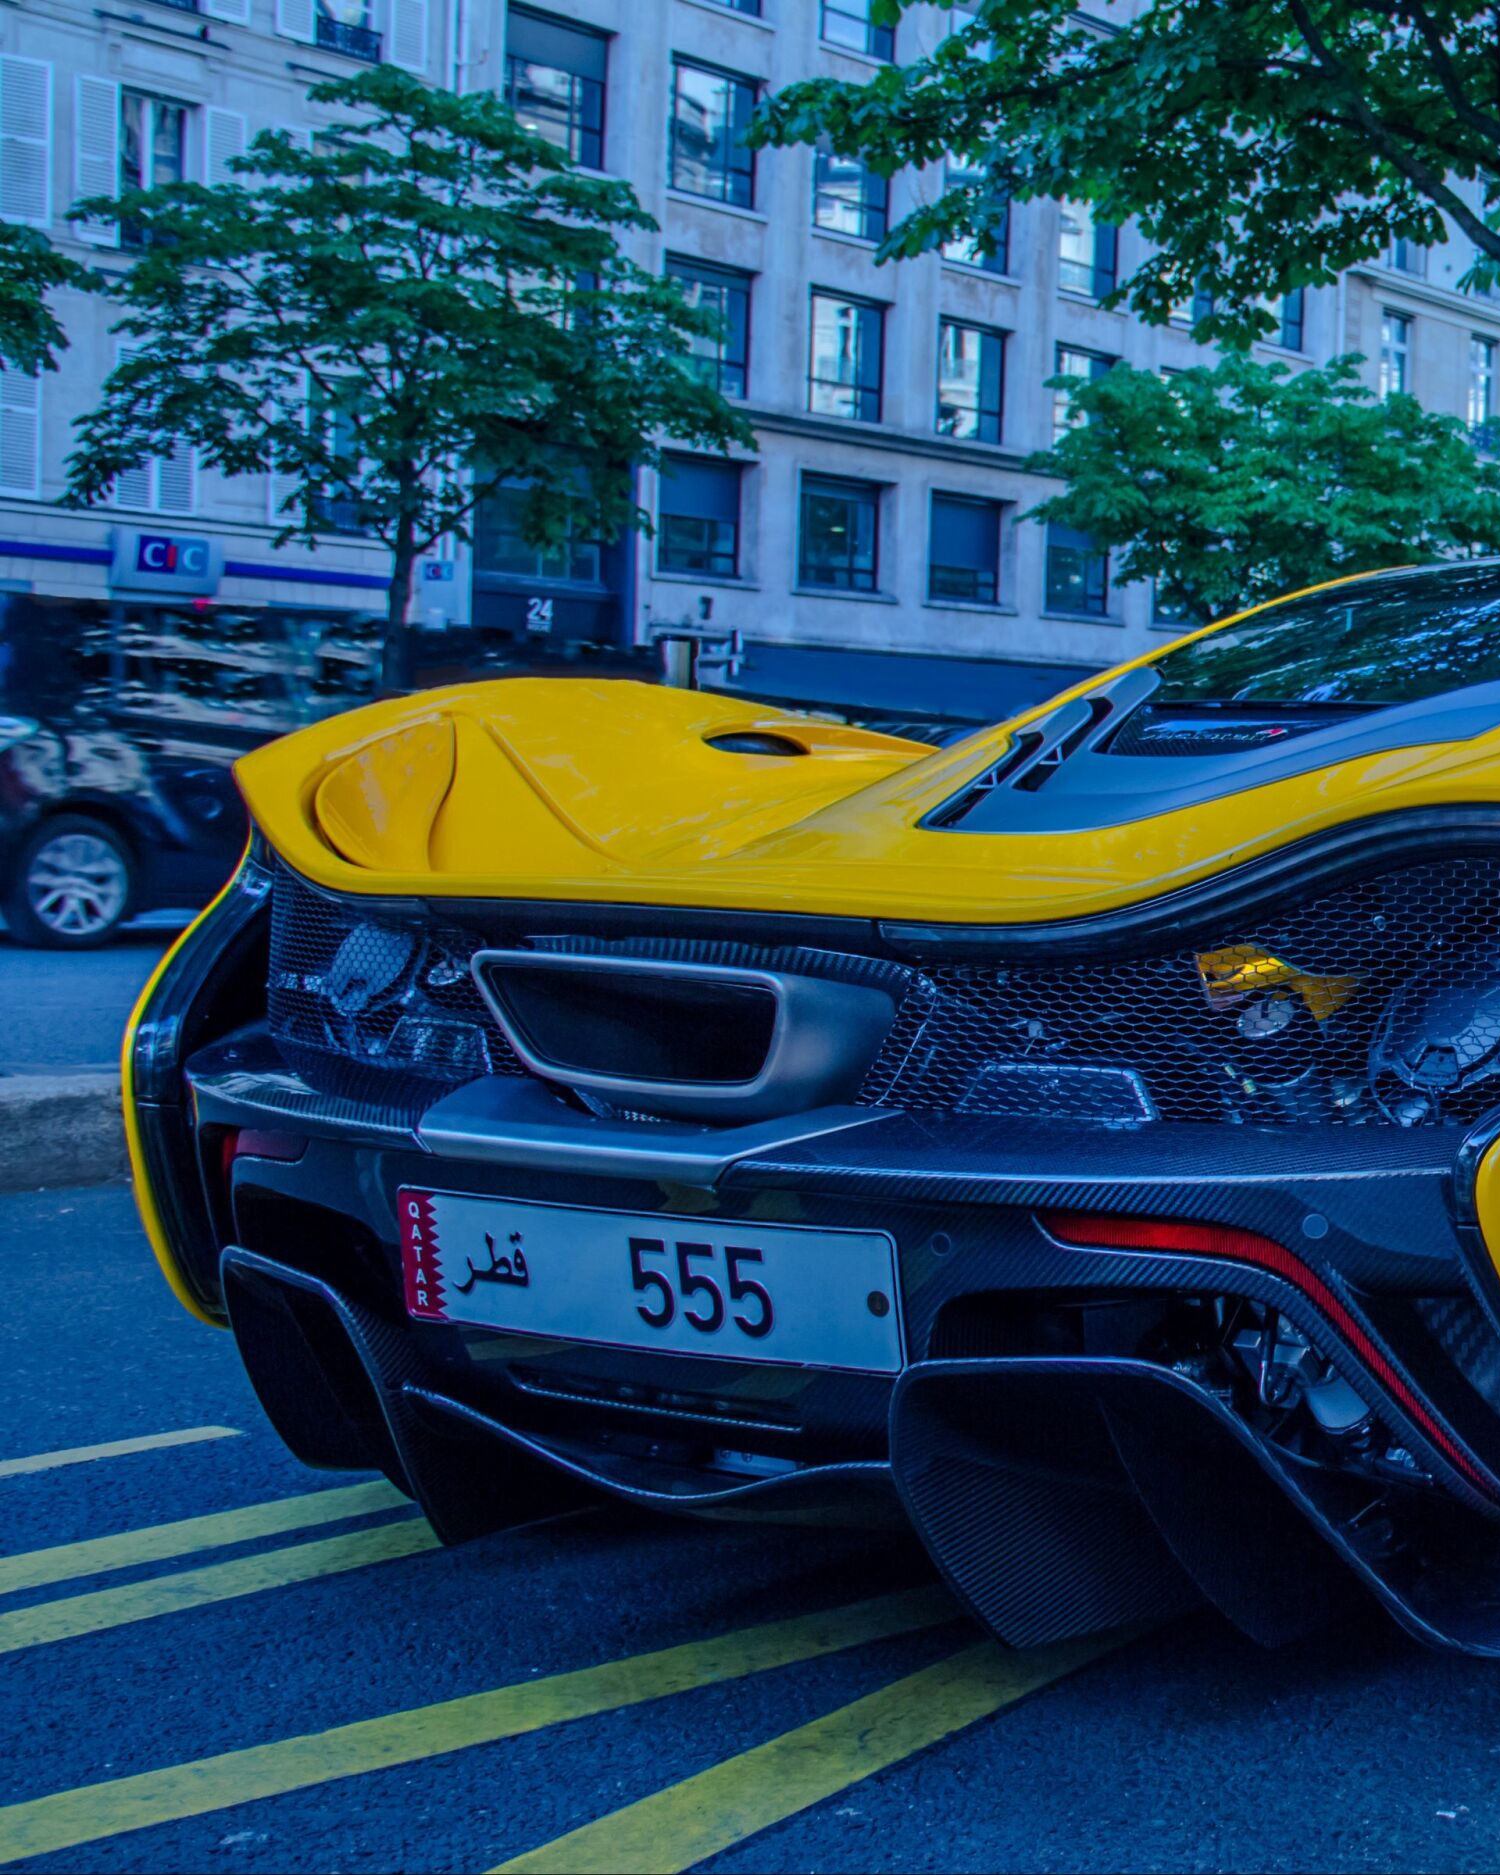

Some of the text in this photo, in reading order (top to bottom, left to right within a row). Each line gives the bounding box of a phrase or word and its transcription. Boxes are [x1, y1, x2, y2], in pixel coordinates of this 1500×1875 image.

[143, 542, 204, 571] CIC
[426, 565, 450, 579] CIC
[527, 597, 553, 621] 24
[408, 1201, 428, 1307] QATAR
[452, 1231, 529, 1296] قطر
[628, 1237, 773, 1338] 555
